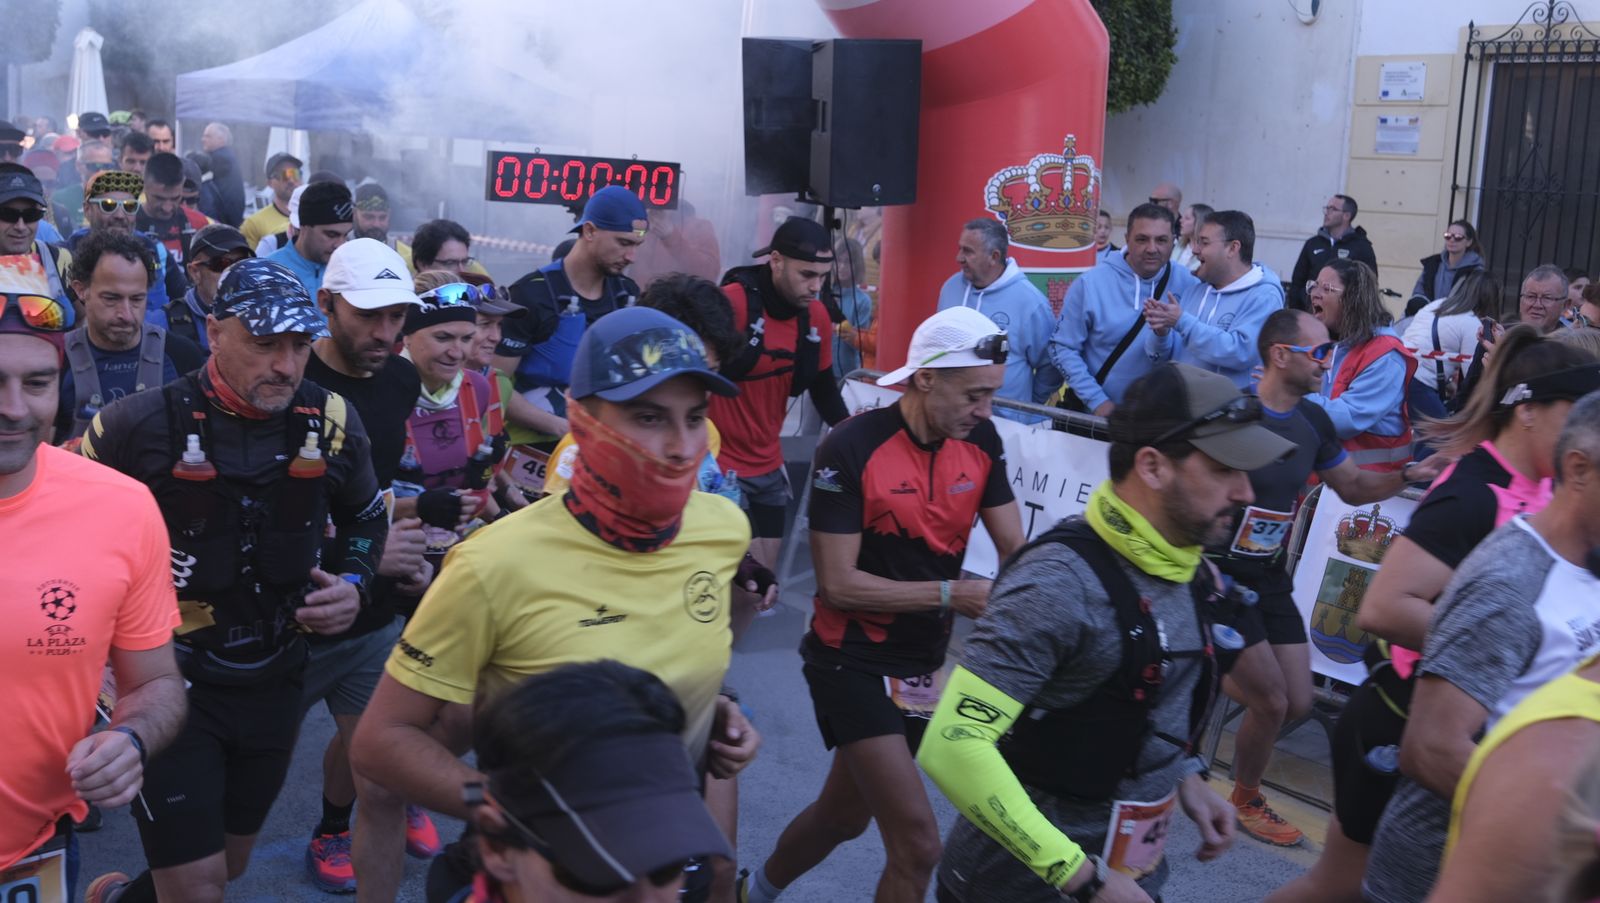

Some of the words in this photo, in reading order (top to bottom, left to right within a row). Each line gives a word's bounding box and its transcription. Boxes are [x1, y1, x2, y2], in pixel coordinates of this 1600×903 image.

[495, 156, 674, 206] 00:00:00
[1012, 466, 1092, 504] AMIE
[1252, 521, 1285, 535] 37
[27, 638, 44, 647] LA
[47, 637, 87, 647] PLAZA
